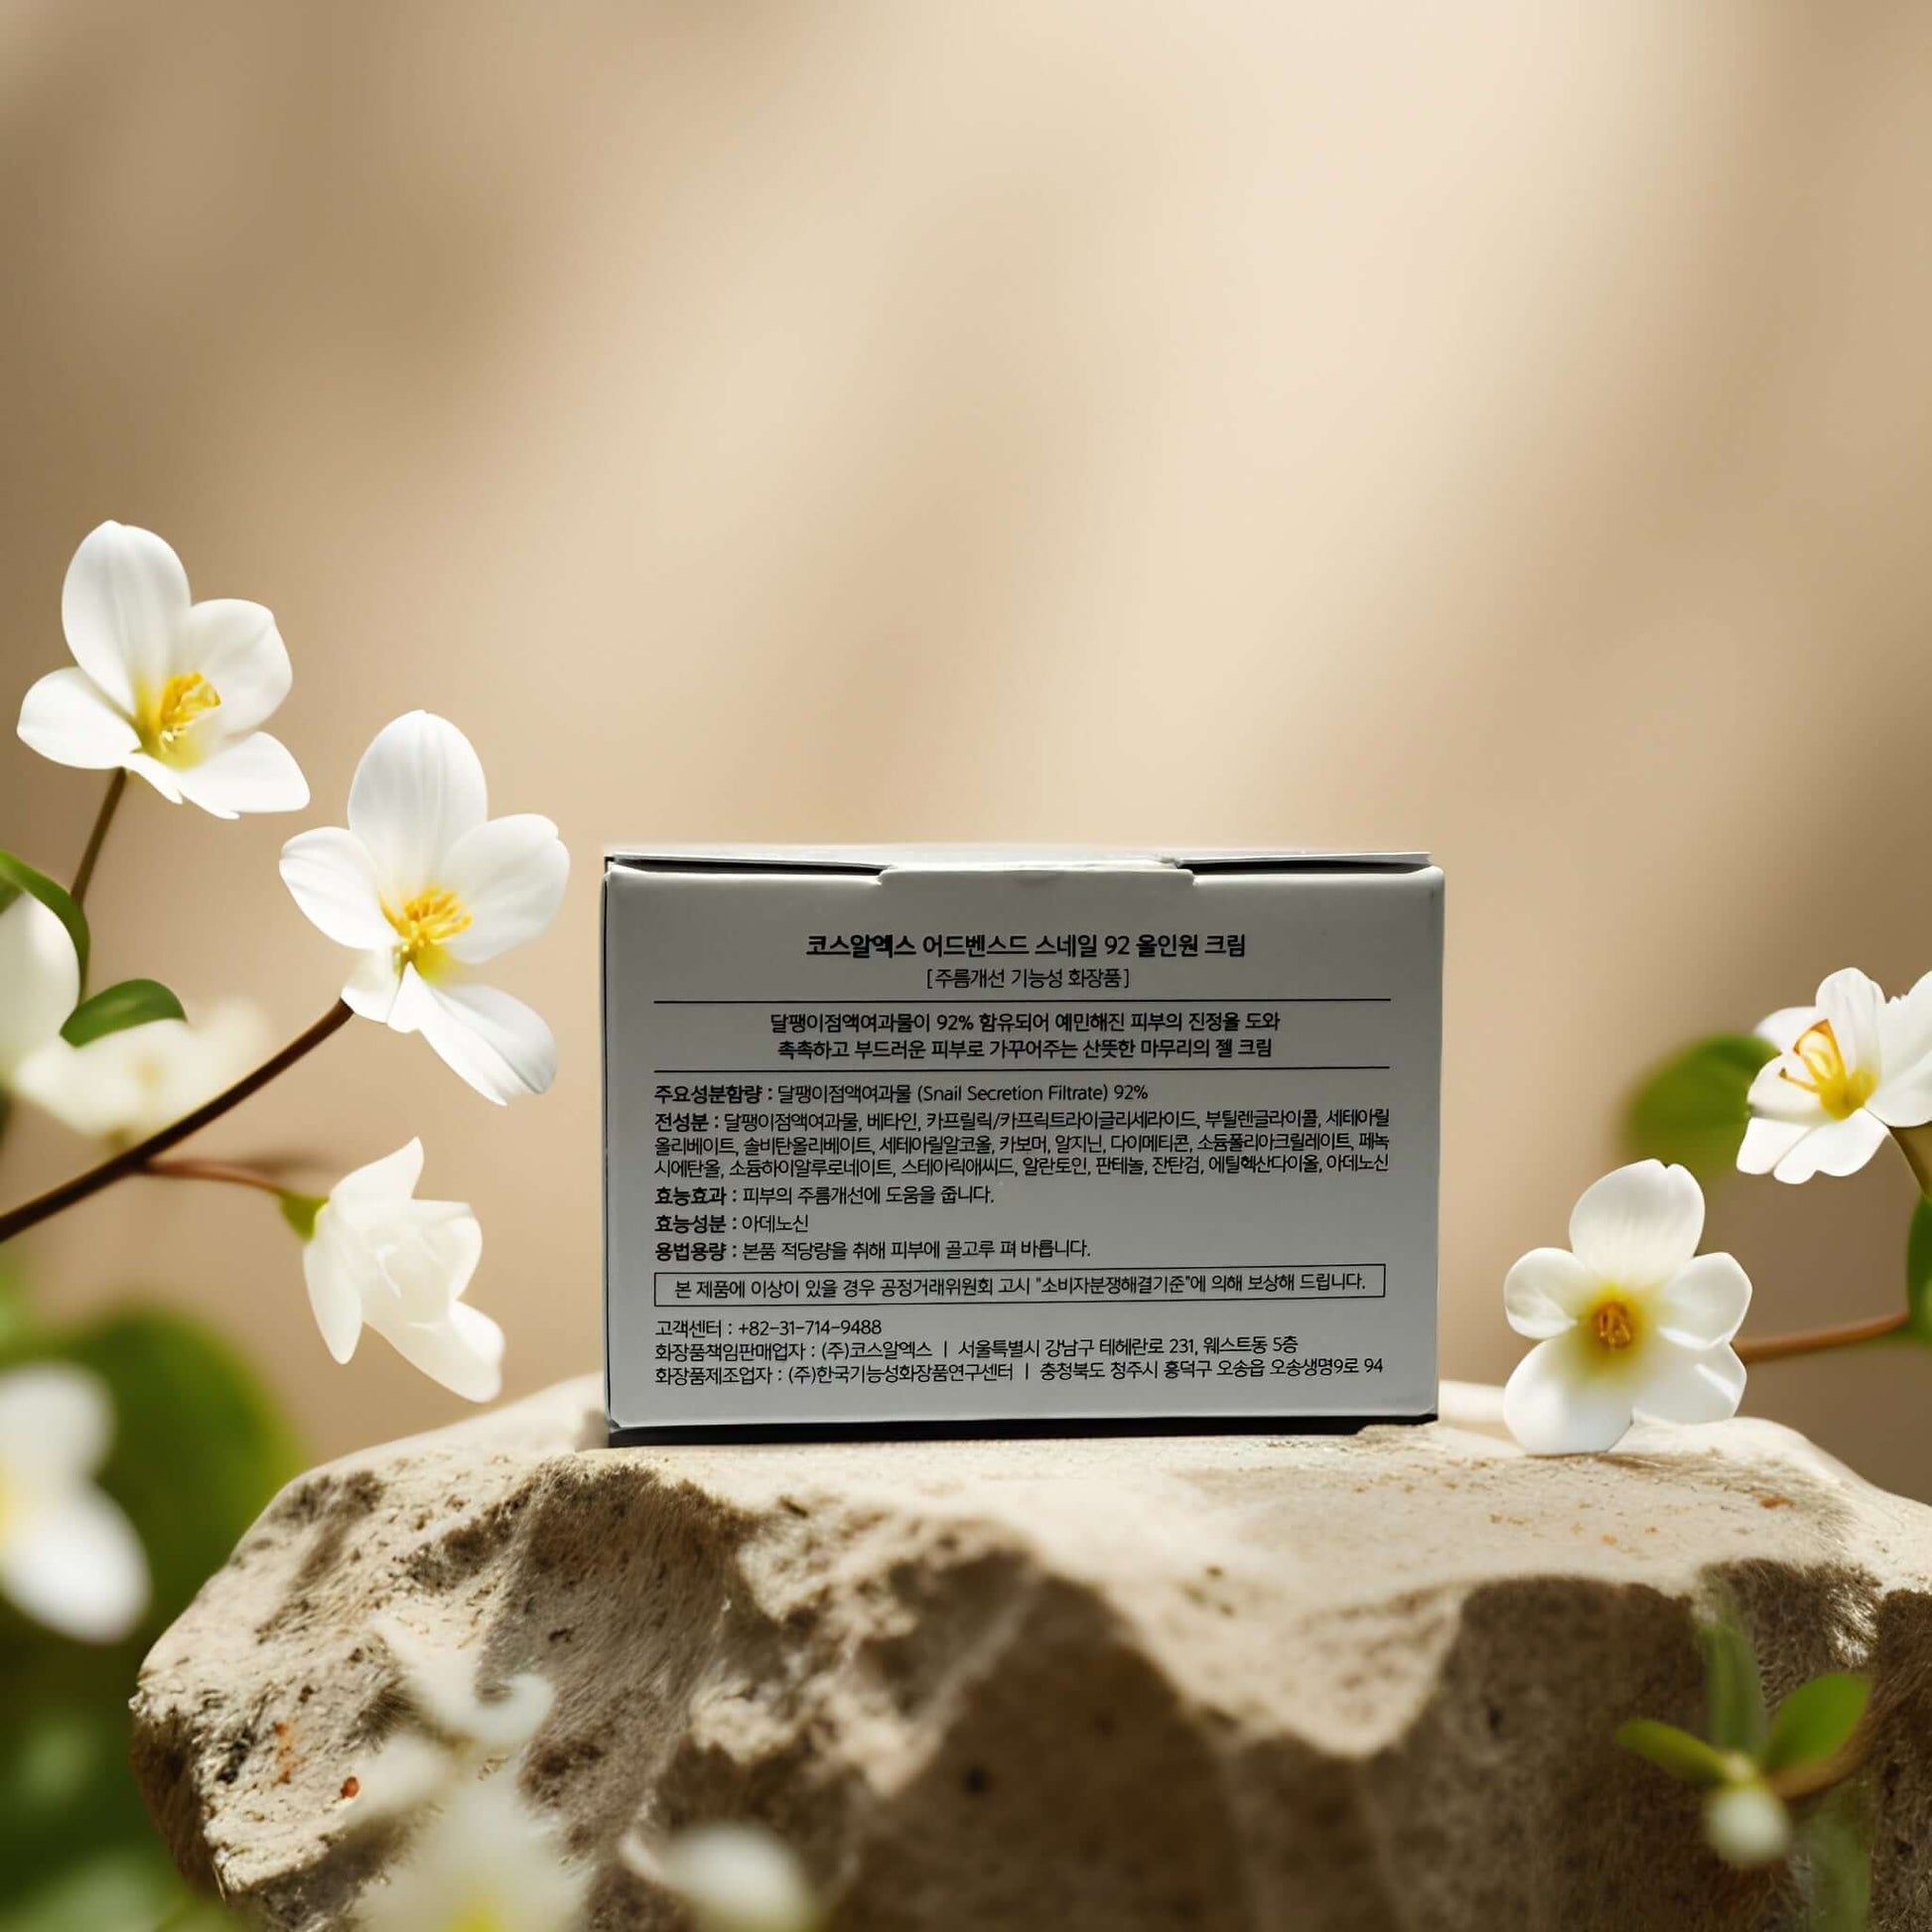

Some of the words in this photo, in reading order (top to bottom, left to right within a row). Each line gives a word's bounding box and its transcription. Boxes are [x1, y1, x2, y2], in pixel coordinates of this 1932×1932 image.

[805, 934, 917, 959] 코스알엑스
[921, 934, 1031, 958] 어드벤스드
[1034, 934, 1098, 958] 스네일
[1104, 935, 1131, 955] 92
[1135, 934, 1199, 958] 올인원
[1203, 934, 1246, 957] 크림
[1011, 968, 1063, 989] 기능성
[769, 1013, 930, 1034] 달팽이점액여과물이
[936, 1015, 975, 1031] 92%
[978, 1013, 1049, 1033] 함유되어
[1054, 1013, 1126, 1033] 예민해진
[1130, 1013, 1183, 1032] 피부의
[1187, 1012, 1241, 1032] 진정을
[1244, 1012, 1282, 1032] 도와
[776, 1040, 851, 1060] 촉촉하고
[854, 1039, 927, 1060] 부드러운
[930, 1040, 986, 1059] 피부로
[989, 1039, 1079, 1059] 가꾸어주는
[1082, 1038, 1137, 1058] 산뜻한
[1140, 1038, 1210, 1058] 마무리의
[1214, 1038, 1233, 1058] 젤
[1237, 1037, 1273, 1057] 크림
[653, 1084, 763, 1104] 주요성분함량
[777, 1084, 912, 1104] 달팽이점액여과물
[916, 1085, 962, 1103] (Snail
[966, 1085, 1043, 1101] Secretion
[1047, 1084, 1109, 1102] Filtrate)
[1113, 1084, 1150, 1100] 92%
[654, 1112, 710, 1132] 전성분
[724, 1113, 863, 1132] 달팽이점액여과물,
[867, 1112, 922, 1132] 베타인,
[1204, 1109, 1321, 1129] 부틸렌글라이콜,
[1324, 1108, 1390, 1127] 세테아릴
[653, 1137, 740, 1157] 올리베이트,
[743, 1137, 877, 1156] 솔비탄올리베이트,
[879, 1135, 996, 1155] 세테아릴알코올,
[999, 1136, 1051, 1154] 카보머,
[1054, 1135, 1107, 1155] 알지닌,
[1110, 1135, 1193, 1154] 다이메티콘,
[1358, 1132, 1390, 1150] 페녹
[653, 1160, 725, 1179] 시에탄올,
[728, 1159, 897, 1177] 소듐하이알루로네이트,
[900, 1158, 1019, 1176] 스테아릭애씨드,
[1022, 1157, 1092, 1176] 알란토인,
[1095, 1157, 1149, 1175] 판테놀,
[1152, 1156, 1205, 1174] 잔탄검,
[1208, 1155, 1323, 1174] 에틸헥산다이올,
[1325, 1154, 1389, 1173] 아데노신
[653, 1186, 728, 1206] 효능효과
[742, 1187, 792, 1205] 피부의
[796, 1186, 882, 1205] 주름개선에
[885, 1185, 937, 1204] 도움을
[939, 1185, 995, 1204] 줍니다.
[653, 1215, 728, 1234] 효능성분
[741, 1214, 809, 1233] 아데노신
[654, 1242, 728, 1262] 용법용량
[742, 1243, 777, 1261] 본품
[780, 1241, 849, 1261] 적당량을
[852, 1241, 887, 1260] 취해
[890, 1241, 940, 1260] 피부에
[944, 1241, 996, 1259] 골고루
[999, 1240, 1017, 1258] 펴
[1020, 1239, 1091, 1258] 바릅니다.
[674, 1281, 693, 1299] 본
[695, 1280, 746, 1299] 제품에
[751, 1280, 799, 1299] 이상이
[804, 1280, 839, 1298] 있을
[842, 1279, 877, 1298] 경우
[879, 1278, 994, 1297] 공정거래위원회
[997, 1277, 1031, 1295] 고시
[1210, 1275, 1243, 1293] 의해
[1246, 1274, 1296, 1292] 보상해
[1299, 1273, 1366, 1291] 드립니다.
[654, 1319, 722, 1338] 고객센터
[738, 1319, 883, 1336] +82-31-714-9488
[654, 1342, 807, 1362] 화장품책임판매업자
[821, 1341, 933, 1360] (주)코스알엑스
[957, 1339, 1040, 1358] 서울특별시
[1044, 1339, 1095, 1357] 강남구
[1099, 1338, 1166, 1356] 테헤란로
[1169, 1338, 1199, 1356] 231,
[1202, 1336, 1269, 1355] 웨스트동
[1272, 1335, 1300, 1353] 5층
[654, 1366, 774, 1386] 화장품제조업자
[787, 1364, 1014, 1384] (주)한국기능성화장품연구센터
[1039, 1362, 1106, 1381] 충청북도
[1110, 1360, 1159, 1380] 청주시
[1163, 1360, 1213, 1379] 흥덕구
[1215, 1359, 1266, 1377] 오송읍
[1269, 1358, 1360, 1377] 오송생명9로
[1363, 1358, 1384, 1373] 94
